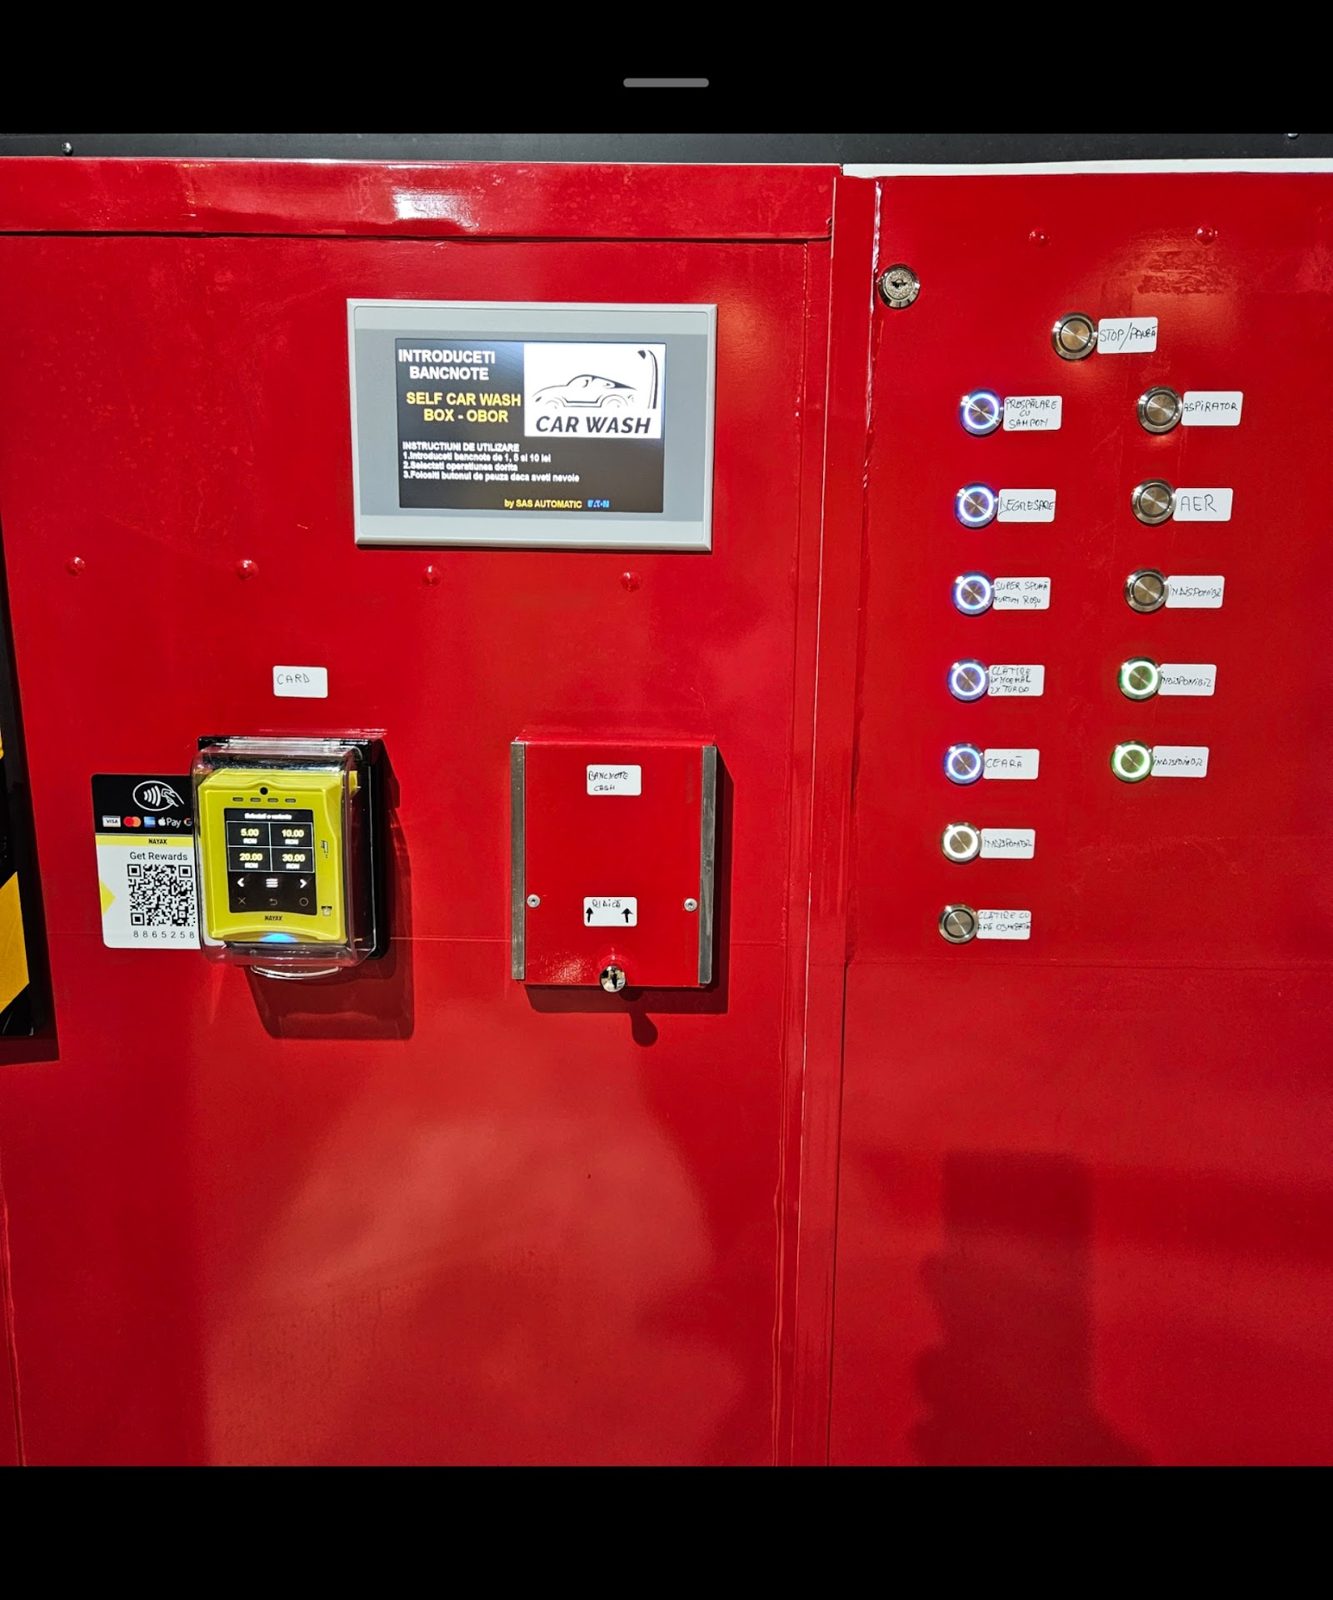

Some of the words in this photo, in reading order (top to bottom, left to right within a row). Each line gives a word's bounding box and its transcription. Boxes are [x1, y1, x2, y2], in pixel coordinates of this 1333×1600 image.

[398, 348, 496, 364] INTRODUCETI
[409, 366, 490, 381] BANCNOTE
[406, 391, 443, 405] SELF
[446, 392, 477, 406] CAR
[479, 393, 522, 407] WASH
[423, 408, 455, 422] BOX
[466, 410, 509, 423] OBOR
[535, 415, 580, 433] CAR
[585, 416, 652, 434] WASH
[402, 441, 461, 451] INSTRUCTIUNI
[463, 442, 476, 452] DE
[477, 443, 520, 452] UTILIZARE
[529, 453, 540, 463] 10
[504, 499, 514, 509] by
[515, 499, 533, 508] SAS
[534, 499, 582, 509] AUTOMATIC
[1180, 493, 1217, 512] AER
[276, 673, 310, 685] CARD
[166, 818, 182, 829] Pay
[240, 828, 260, 837] 5.00
[281, 828, 305, 838] 10.00
[129, 851, 146, 860] Get
[148, 851, 189, 861] Rewards
[239, 852, 263, 861] 20.00
[282, 853, 306, 863] 30.00
